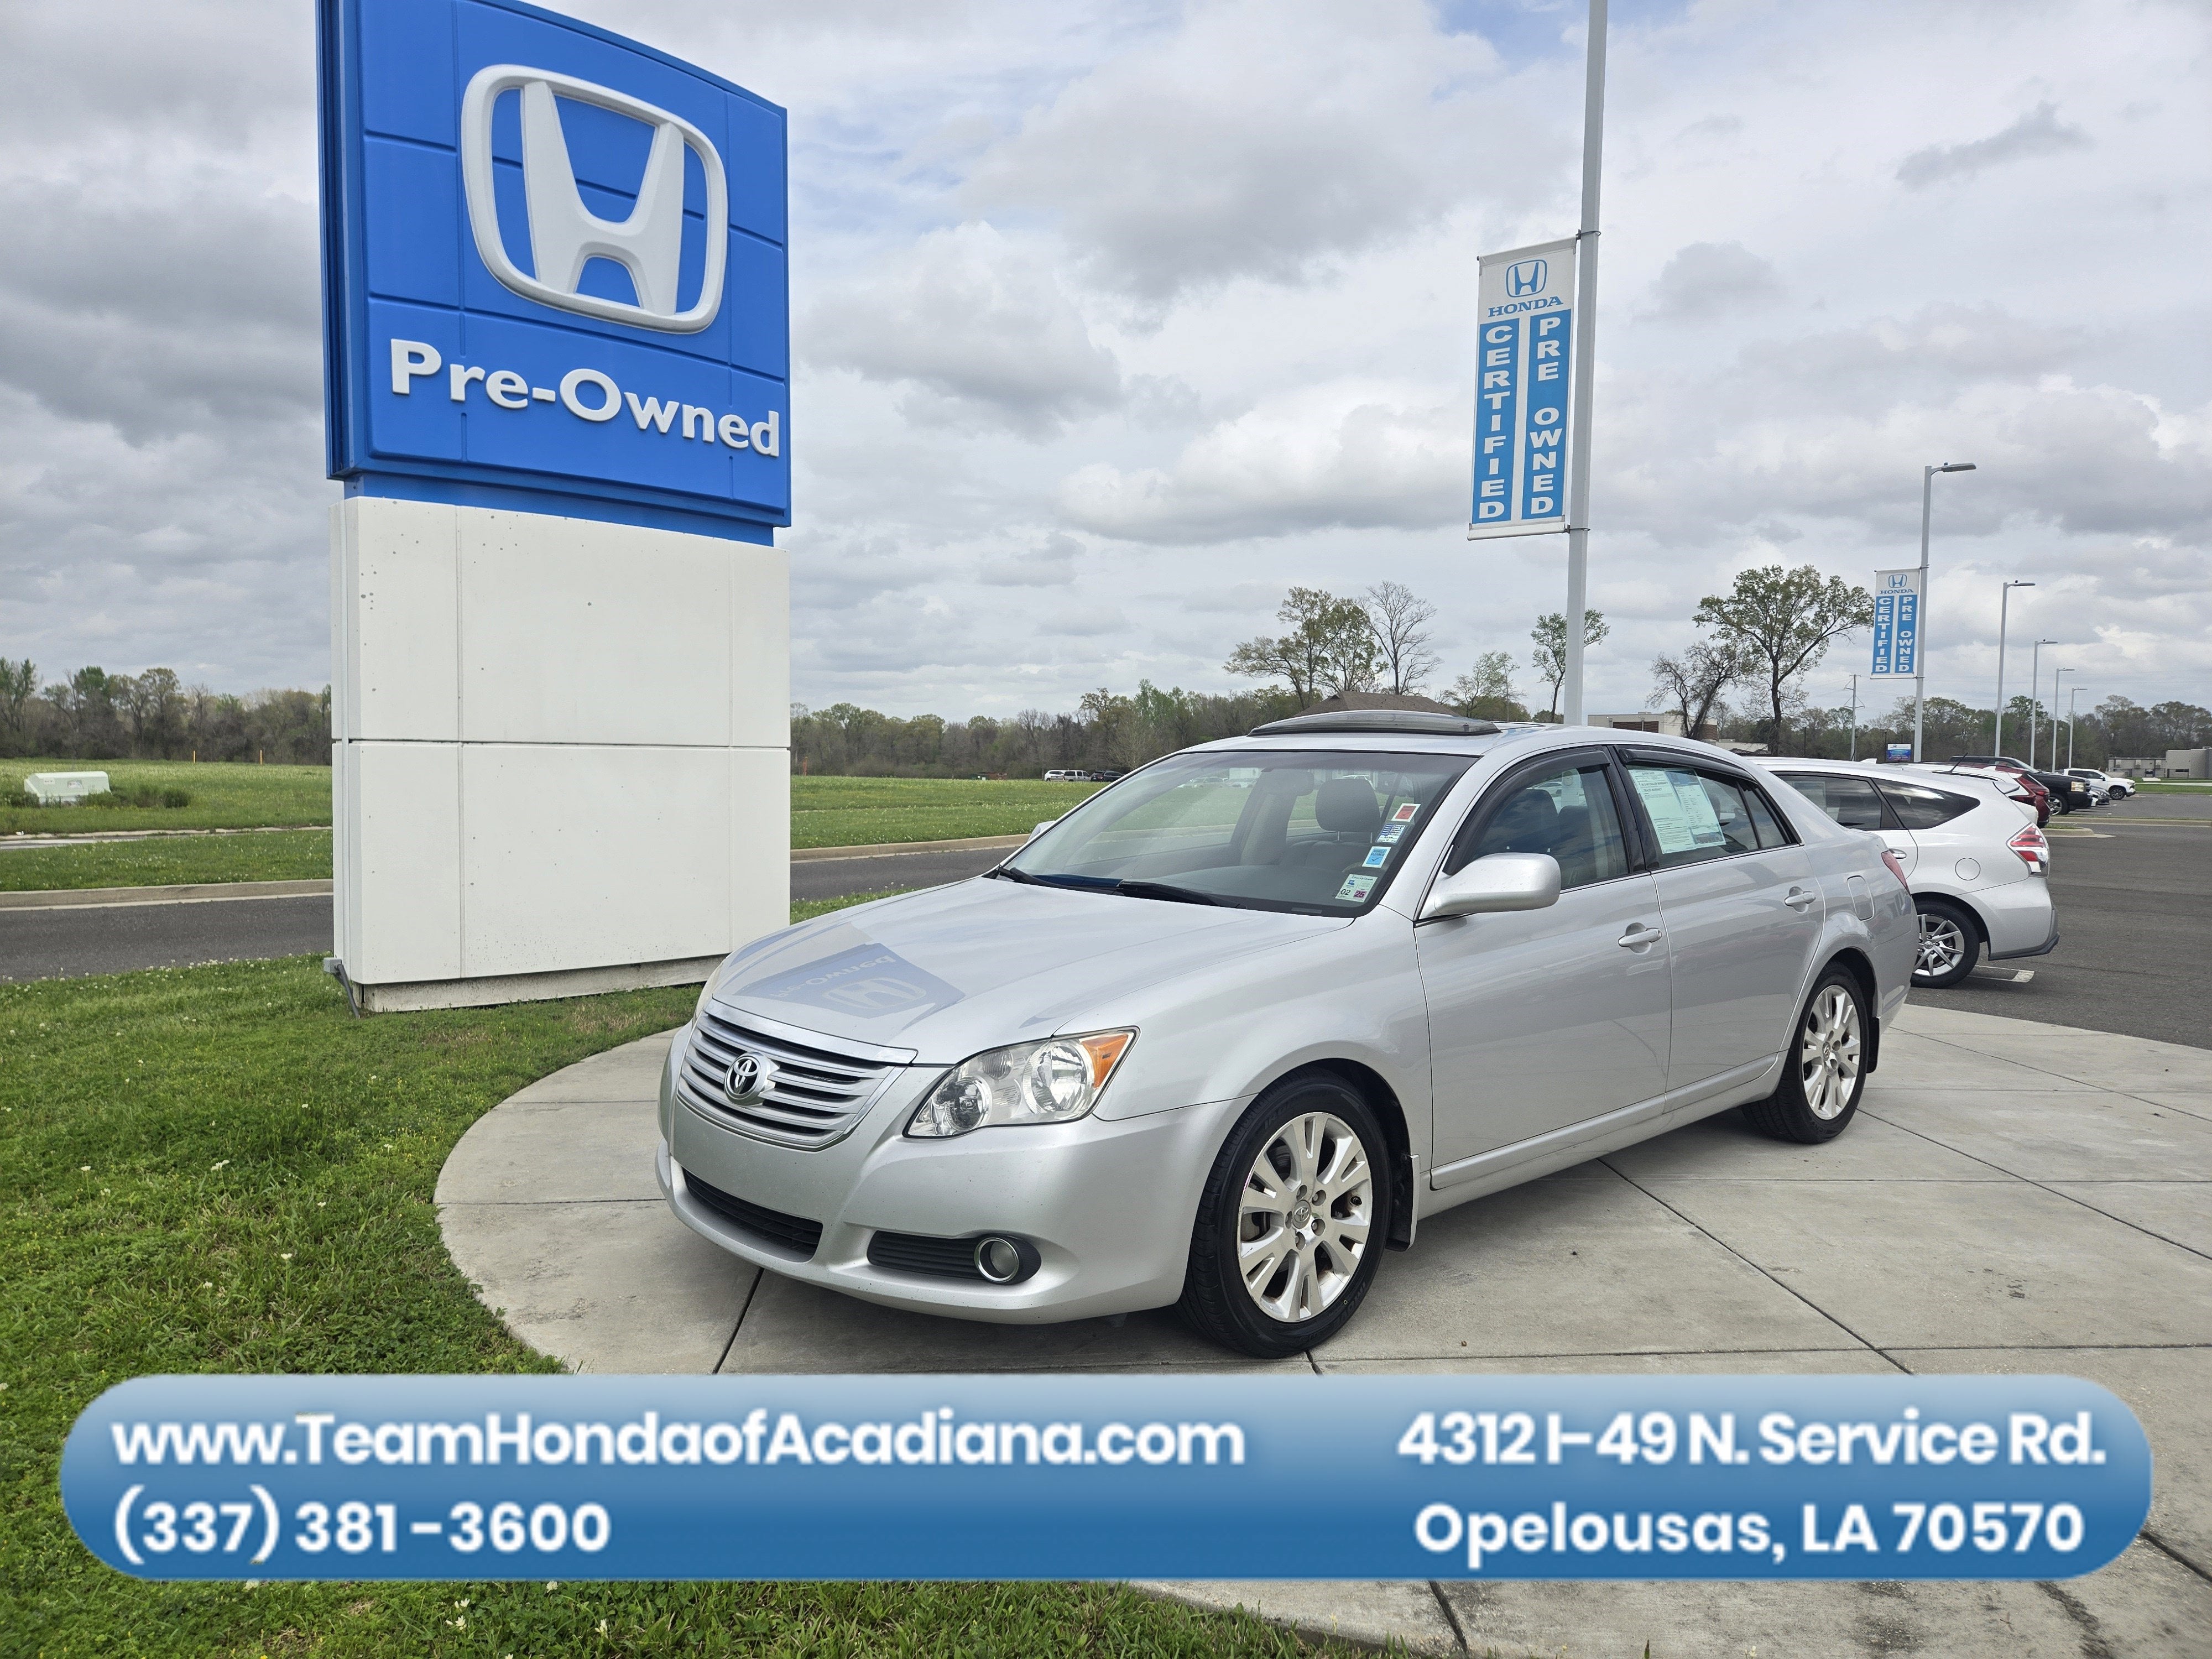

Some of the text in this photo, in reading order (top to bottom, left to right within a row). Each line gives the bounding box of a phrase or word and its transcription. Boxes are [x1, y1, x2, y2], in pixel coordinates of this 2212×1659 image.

[1488, 296, 1563, 317] HONDA
[390, 338, 780, 458] Pre-Owned
[1479, 325, 1513, 519] CERTIFIED
[1530, 316, 1563, 515] PRE OWNED
[1875, 597, 1891, 673] CERTIFIED
[1898, 596, 1913, 672] PRE OWNED
